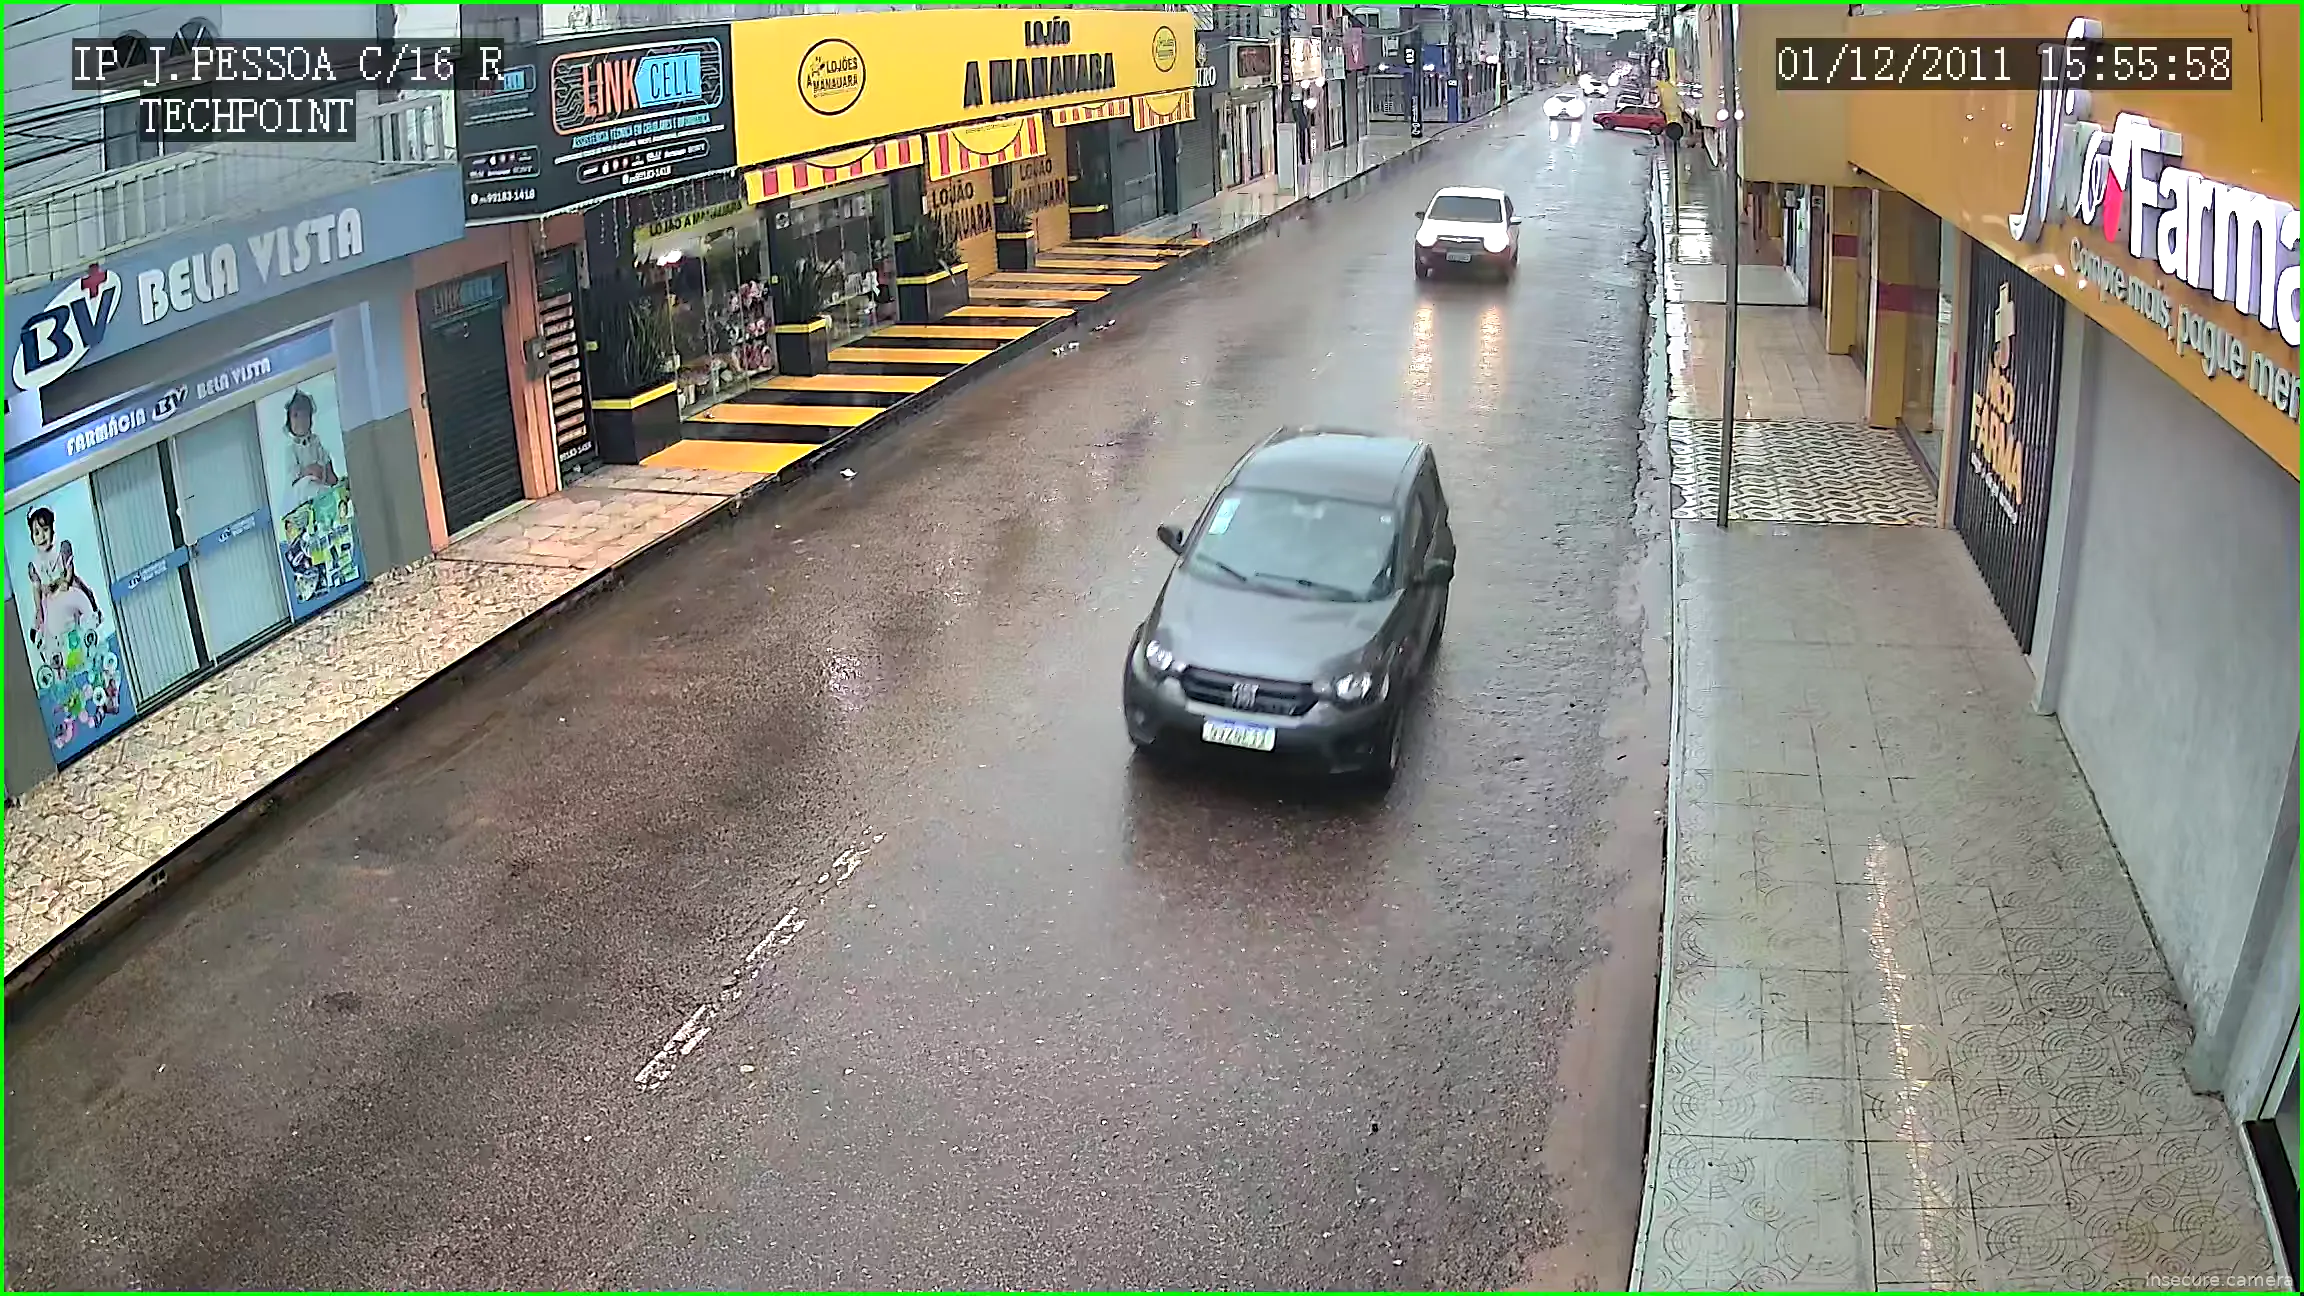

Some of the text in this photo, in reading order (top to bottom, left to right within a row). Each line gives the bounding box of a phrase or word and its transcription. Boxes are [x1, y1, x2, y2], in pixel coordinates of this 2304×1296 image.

[1025, 16, 1071, 47] LOJÃO
[582, 57, 640, 118] LINK
[649, 58, 693, 99] CELL
[963, 52, 1116, 108] A MANAUARA
[931, 180, 974, 209] LOJÃO
[20, 207, 364, 376] BV BELA VISTA
[2070, 236, 2127, 302] Compre
[2176, 303, 2247, 381] pague
[66, 407, 147, 457] FARMÁCIA
[196, 373, 231, 400] BELA
[228, 356, 272, 386] VISTA
